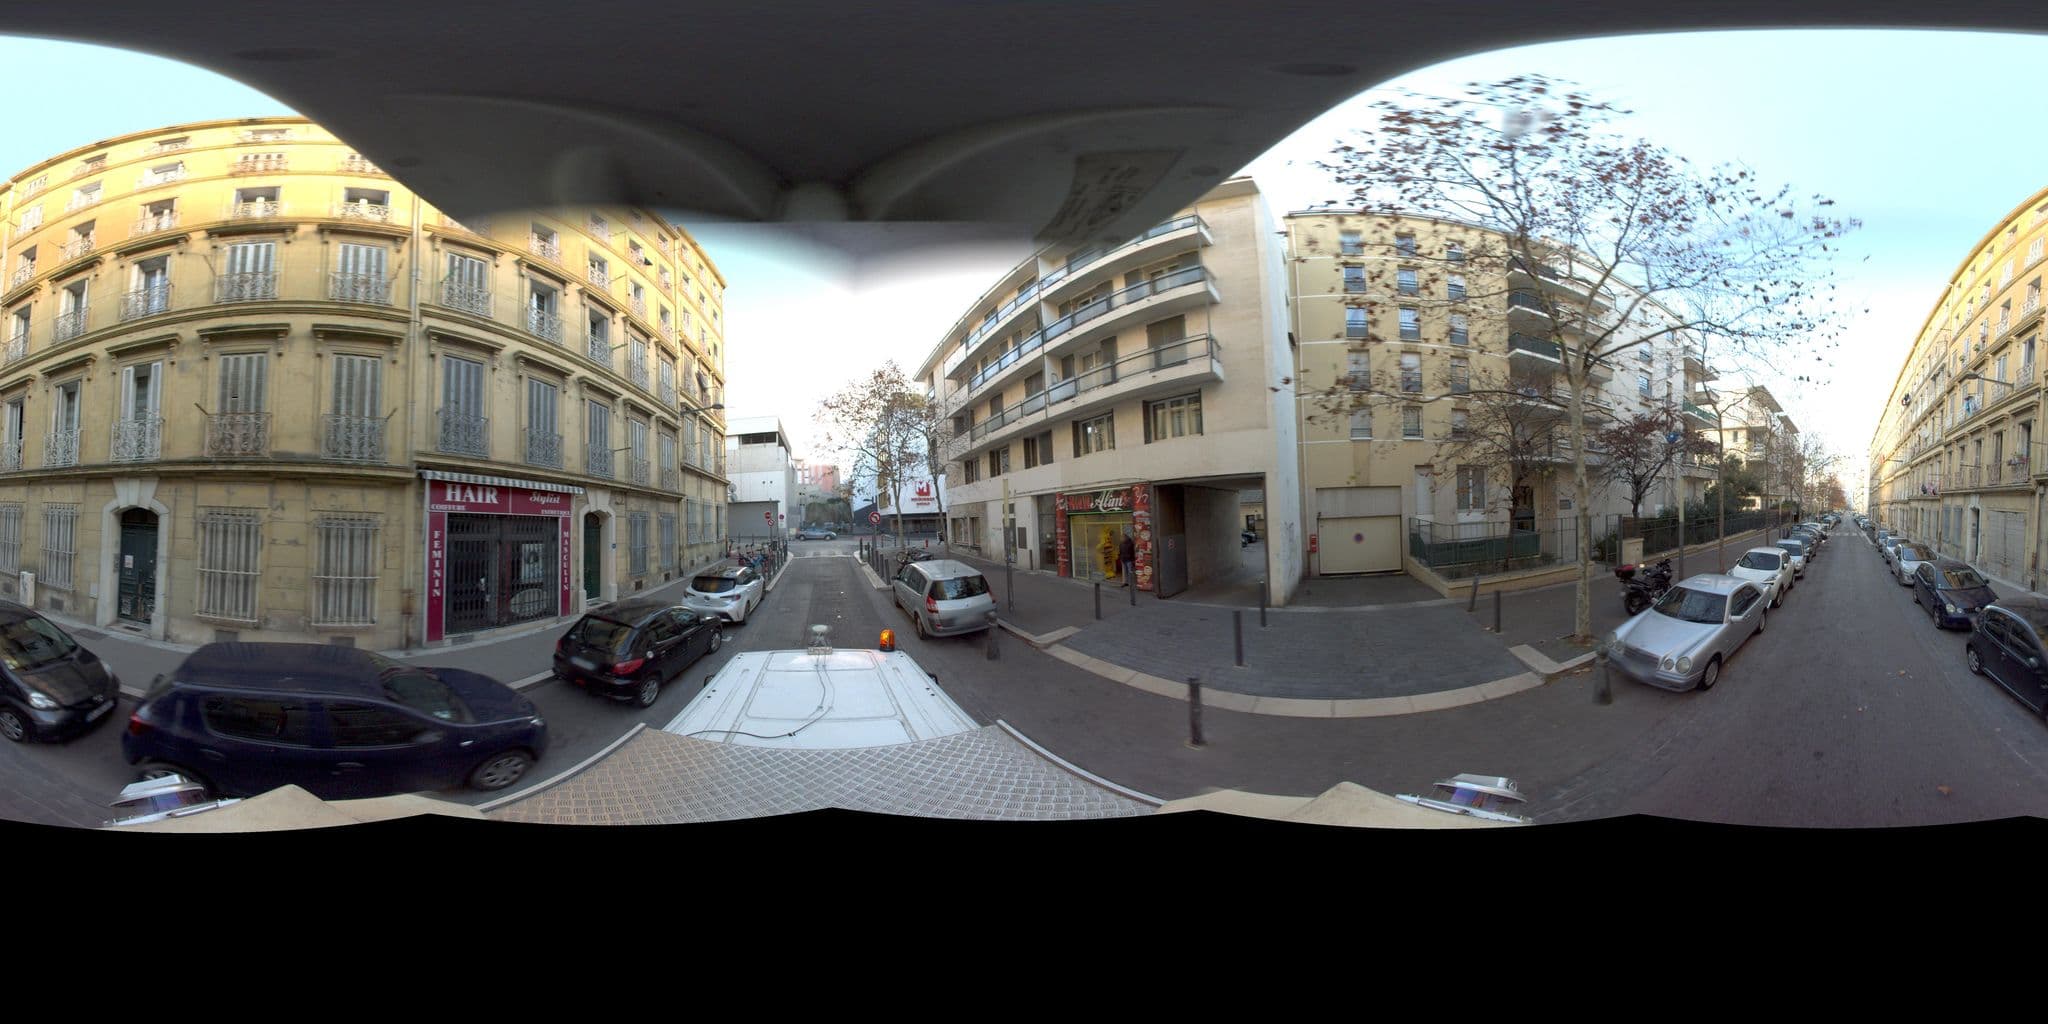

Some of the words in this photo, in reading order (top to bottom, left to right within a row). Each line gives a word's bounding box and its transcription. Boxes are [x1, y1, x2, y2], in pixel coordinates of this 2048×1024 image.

[445, 483, 499, 504] HAIR
[529, 491, 560, 505] Stylist
[431, 530, 442, 597] FEMININ
